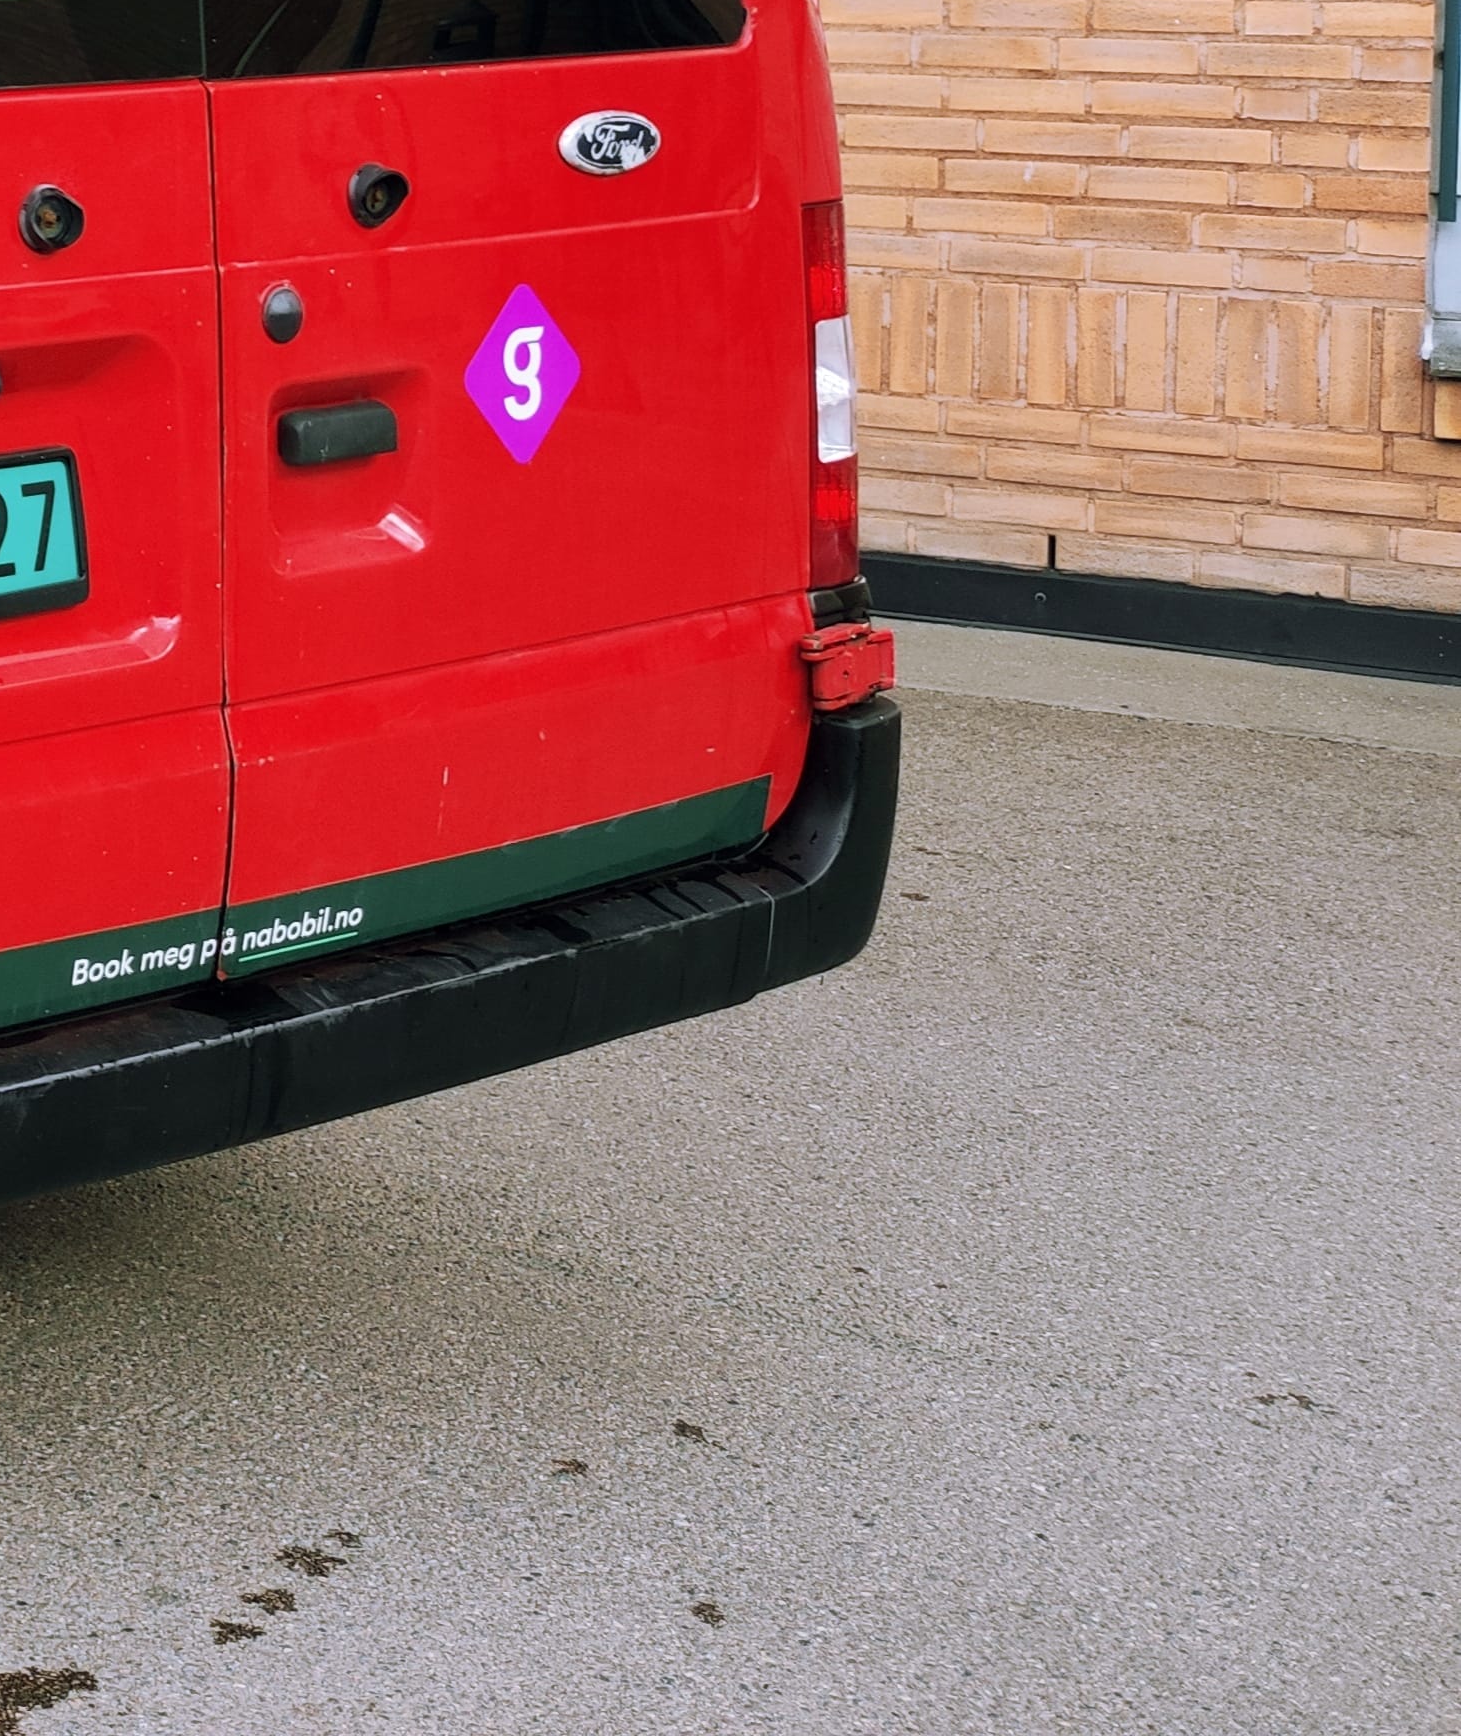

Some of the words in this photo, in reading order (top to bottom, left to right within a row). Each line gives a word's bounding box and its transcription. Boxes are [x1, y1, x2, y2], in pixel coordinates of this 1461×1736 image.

[71, 952, 135, 986] Book
[140, 942, 195, 973] meg
[200, 927, 237, 967] på
[241, 905, 365, 952] nabobil.no
